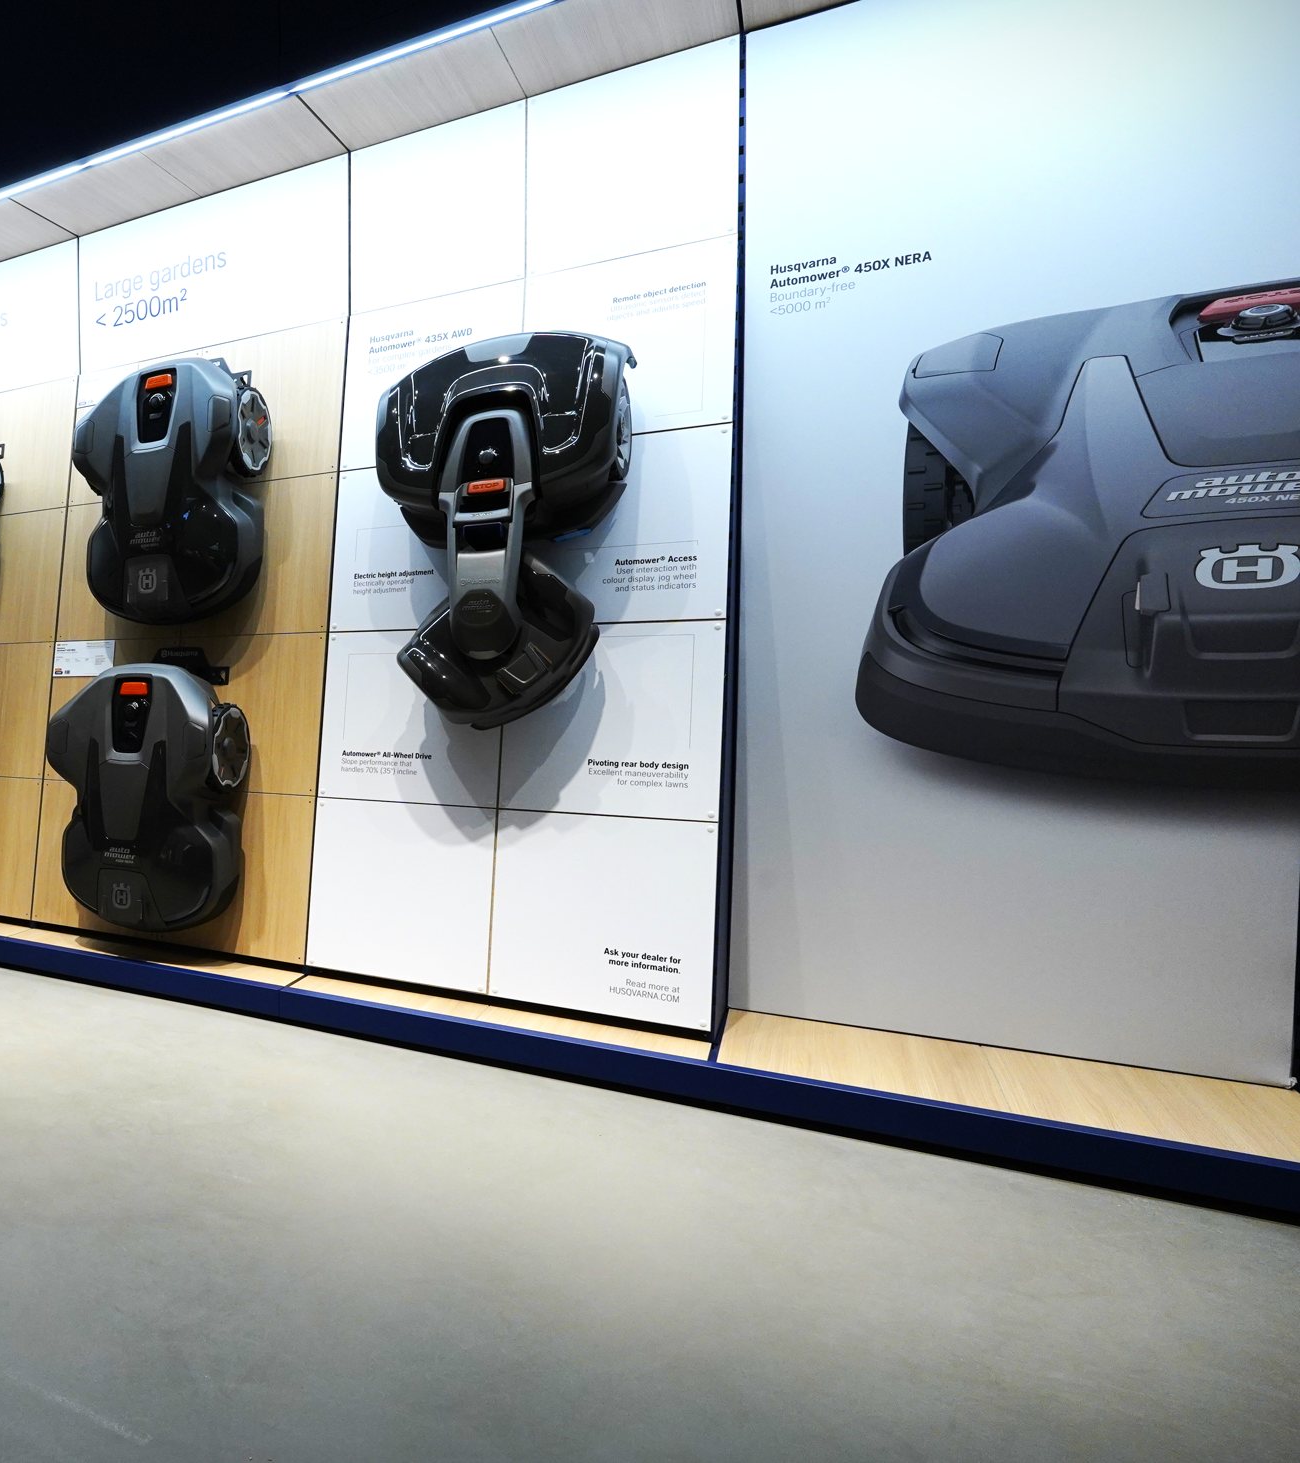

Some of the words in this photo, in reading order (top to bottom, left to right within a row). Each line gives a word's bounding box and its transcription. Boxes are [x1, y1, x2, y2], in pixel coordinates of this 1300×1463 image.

[770, 257, 837, 276] Husqvarna
[854, 258, 890, 274] 450X
[894, 251, 932, 267] NERA
[95, 275, 143, 301] Large
[149, 252, 227, 291] gardens
[612, 293, 641, 304] Remote
[643, 288, 667, 298] object
[669, 281, 707, 293] detection
[770, 281, 856, 302] Boundary-free
[770, 301, 811, 316] <5000
[369, 330, 414, 344] Husqvarna
[425, 331, 449, 343] 435X
[451, 327, 473, 339] AWD
[472, 482, 500, 490] STOP
[1166, 481, 1300, 502] mowe
[1225, 495, 1271, 504] 450X
[668, 555, 697, 563] Access
[353, 572, 376, 580] Electric
[378, 571, 397, 579] height
[399, 569, 434, 578] adjustment
[616, 566, 634, 575] User
[636, 564, 678, 573] interaction
[679, 563, 697, 571] with
[354, 579, 384, 588] Electrically
[387, 577, 414, 587] operated
[602, 576, 626, 585] colour
[658, 574, 671, 583] jog
[673, 572, 697, 580] wheel
[353, 587, 371, 595] height
[373, 586, 407, 595] adjustment
[657, 582, 697, 590] indicators
[383, 751, 413, 759] All-Wheel
[341, 758, 358, 766] Slope
[359, 759, 398, 767] performance
[587, 759, 619, 768] Pivoting
[639, 761, 659, 770] body
[661, 762, 689, 771] design
[397, 768, 418, 776] incline
[588, 768, 622, 776] Excellent
[624, 769, 689, 779] maneuverability
[630, 779, 662, 788] complex
[665, 780, 688, 788] lawns
[603, 947, 619, 956] Ask
[621, 951, 639, 959] your
[641, 952, 668, 962] dealer
[670, 955, 681, 964] for
[608, 959, 629, 967] more
[631, 960, 680, 974] information.
[625, 978, 646, 988] Read
[649, 983, 670, 991] more
[609, 985, 680, 1003] HUSQVARNA.COM
